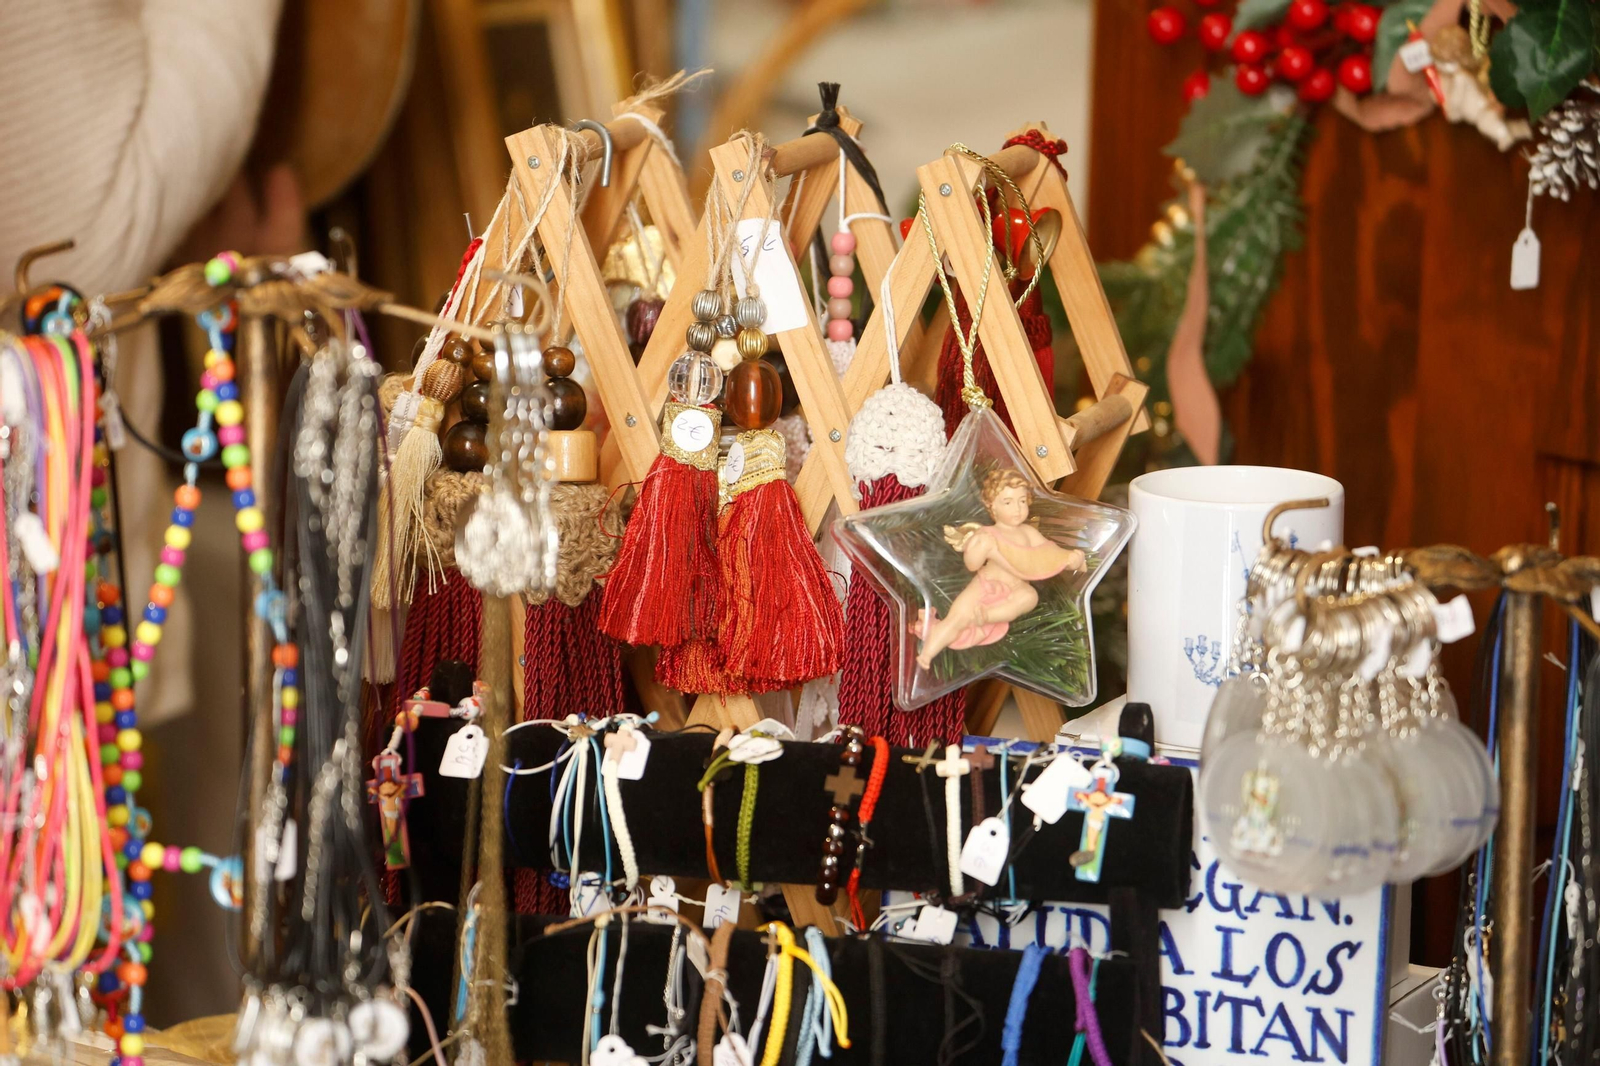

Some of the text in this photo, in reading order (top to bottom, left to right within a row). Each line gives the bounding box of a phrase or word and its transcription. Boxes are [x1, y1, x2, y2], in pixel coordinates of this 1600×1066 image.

[676, 417, 706, 441] 2€
[1185, 850, 1353, 926] GAN.
[1211, 925, 1363, 996] LOS
